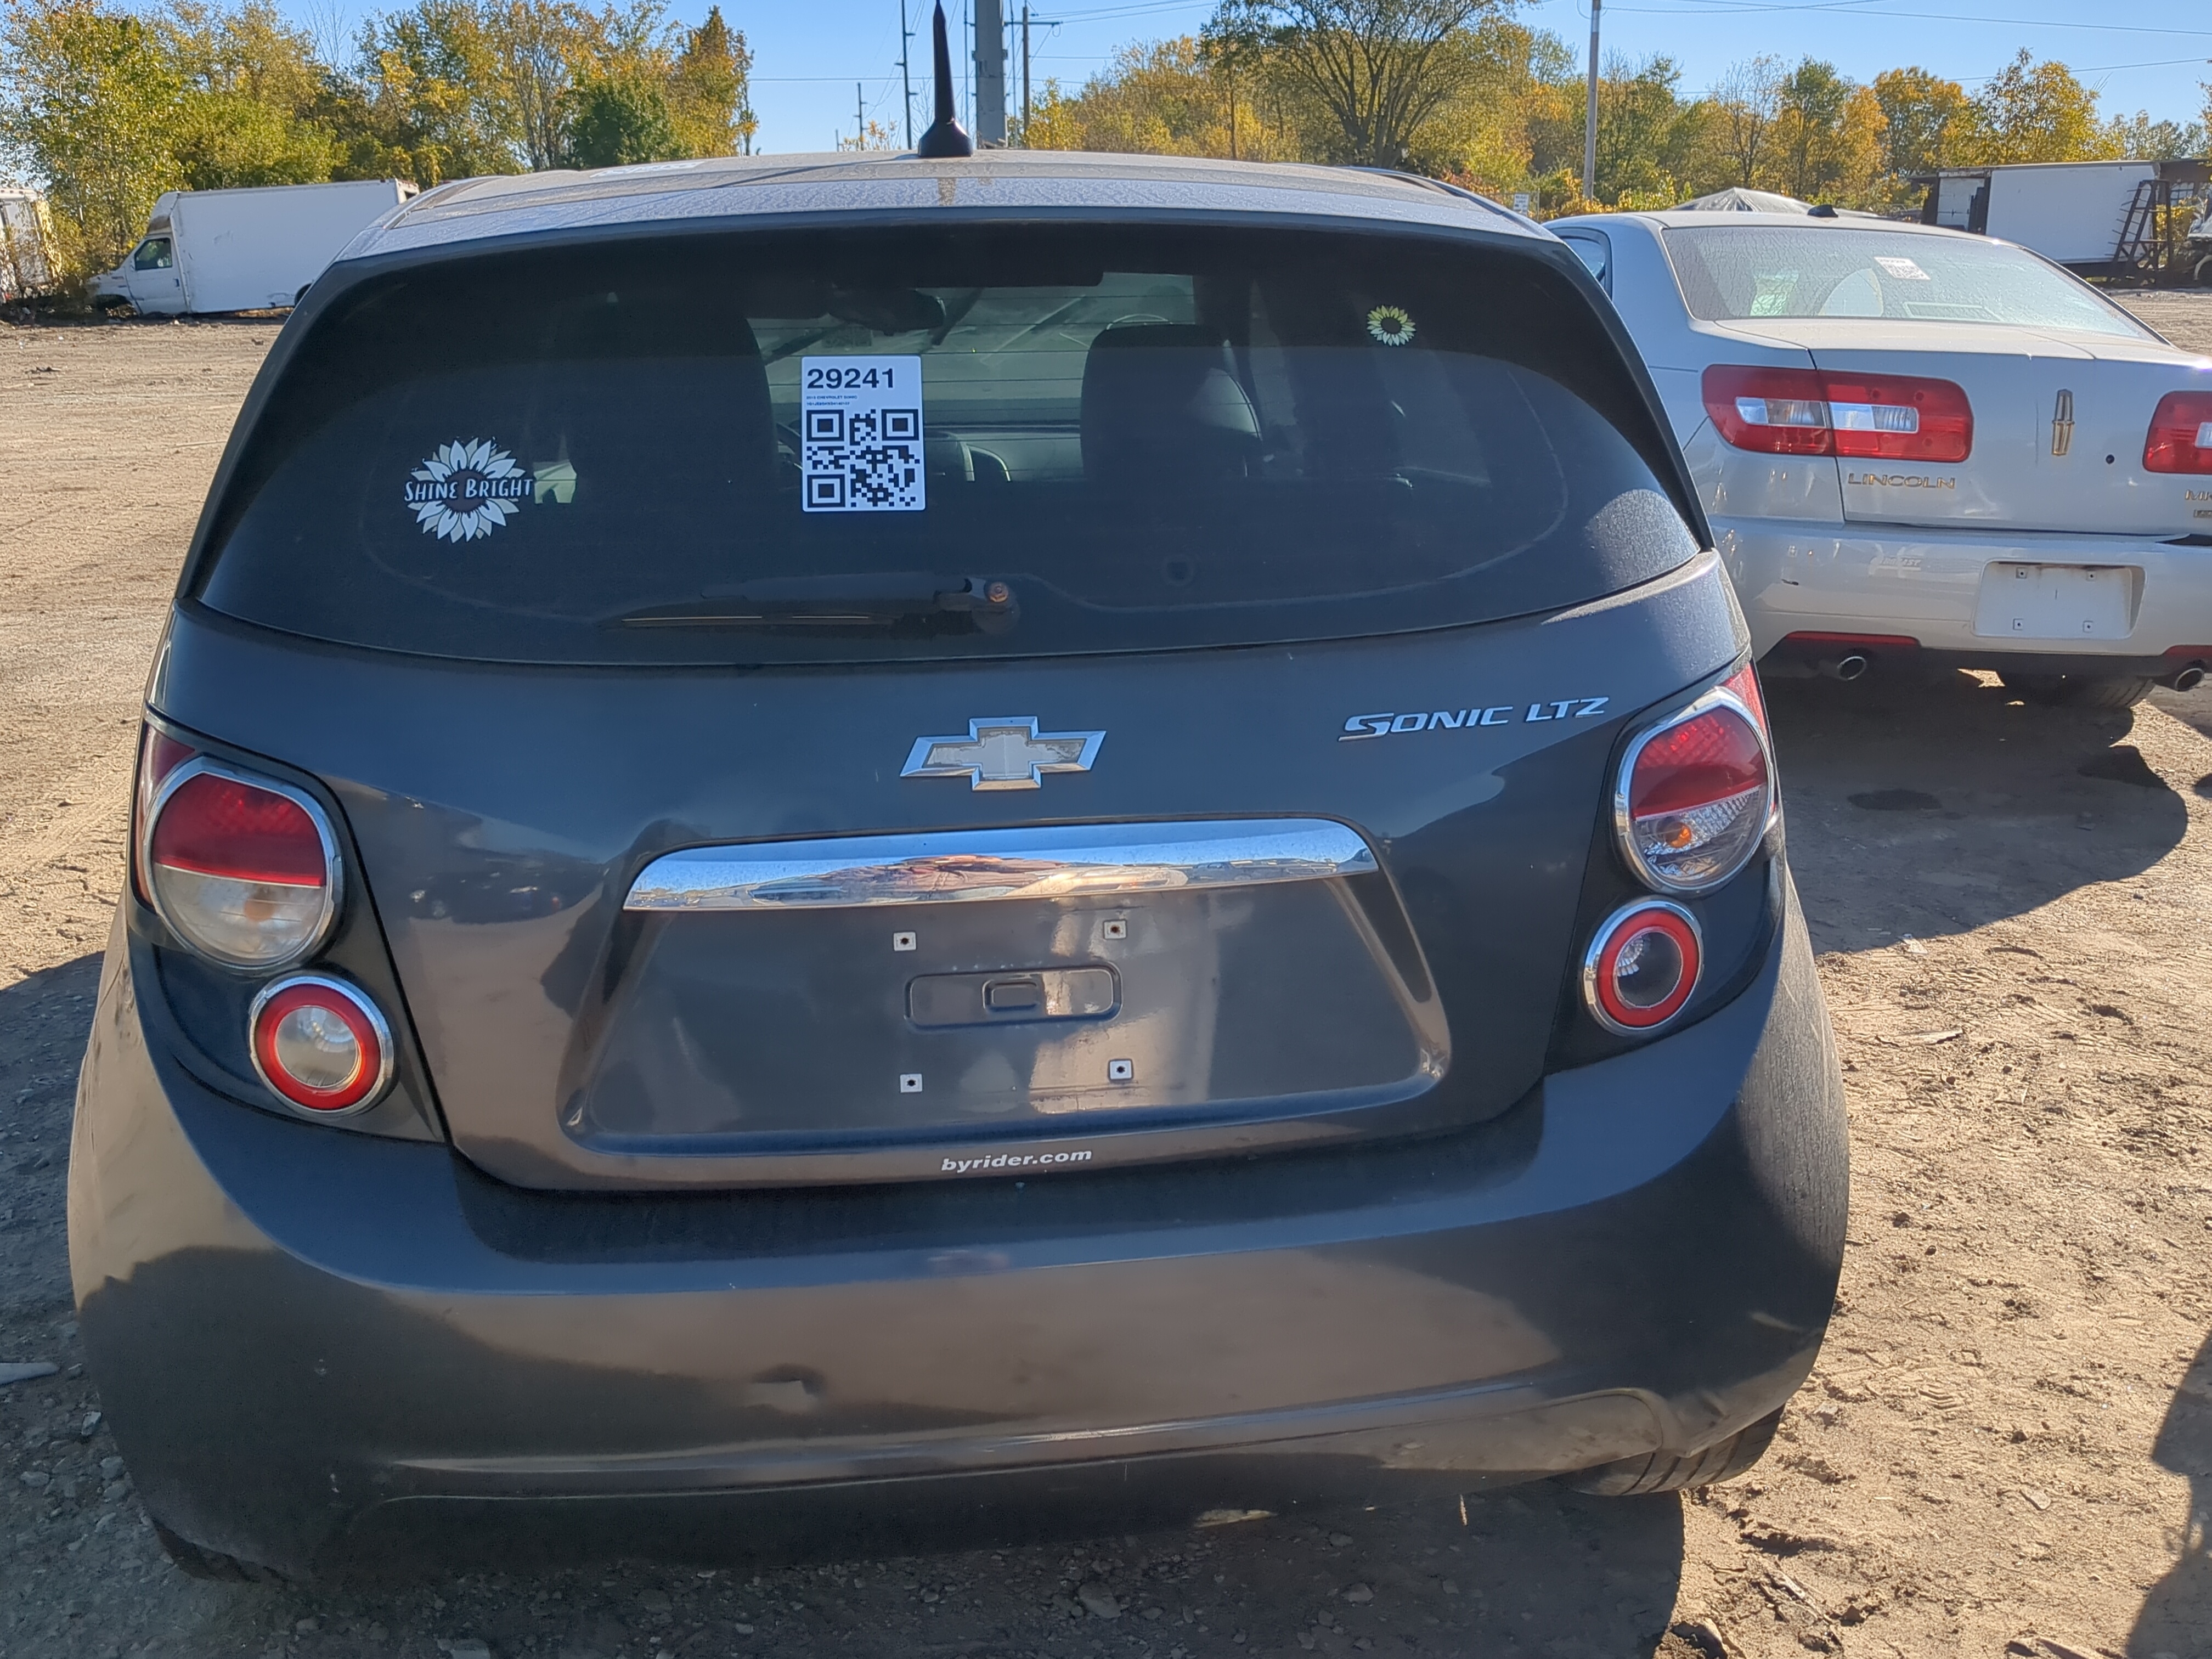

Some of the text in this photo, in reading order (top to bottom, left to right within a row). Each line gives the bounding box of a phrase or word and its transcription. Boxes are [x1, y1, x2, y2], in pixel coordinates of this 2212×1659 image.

[807, 368, 893, 388] 29241
[404, 478, 533, 502] SHINE BRIGHT
[1848, 473, 1956, 489] LINCOLN
[1338, 697, 1610, 741] SONIC LTZ
[941, 1150, 1092, 1173] byrider.com
